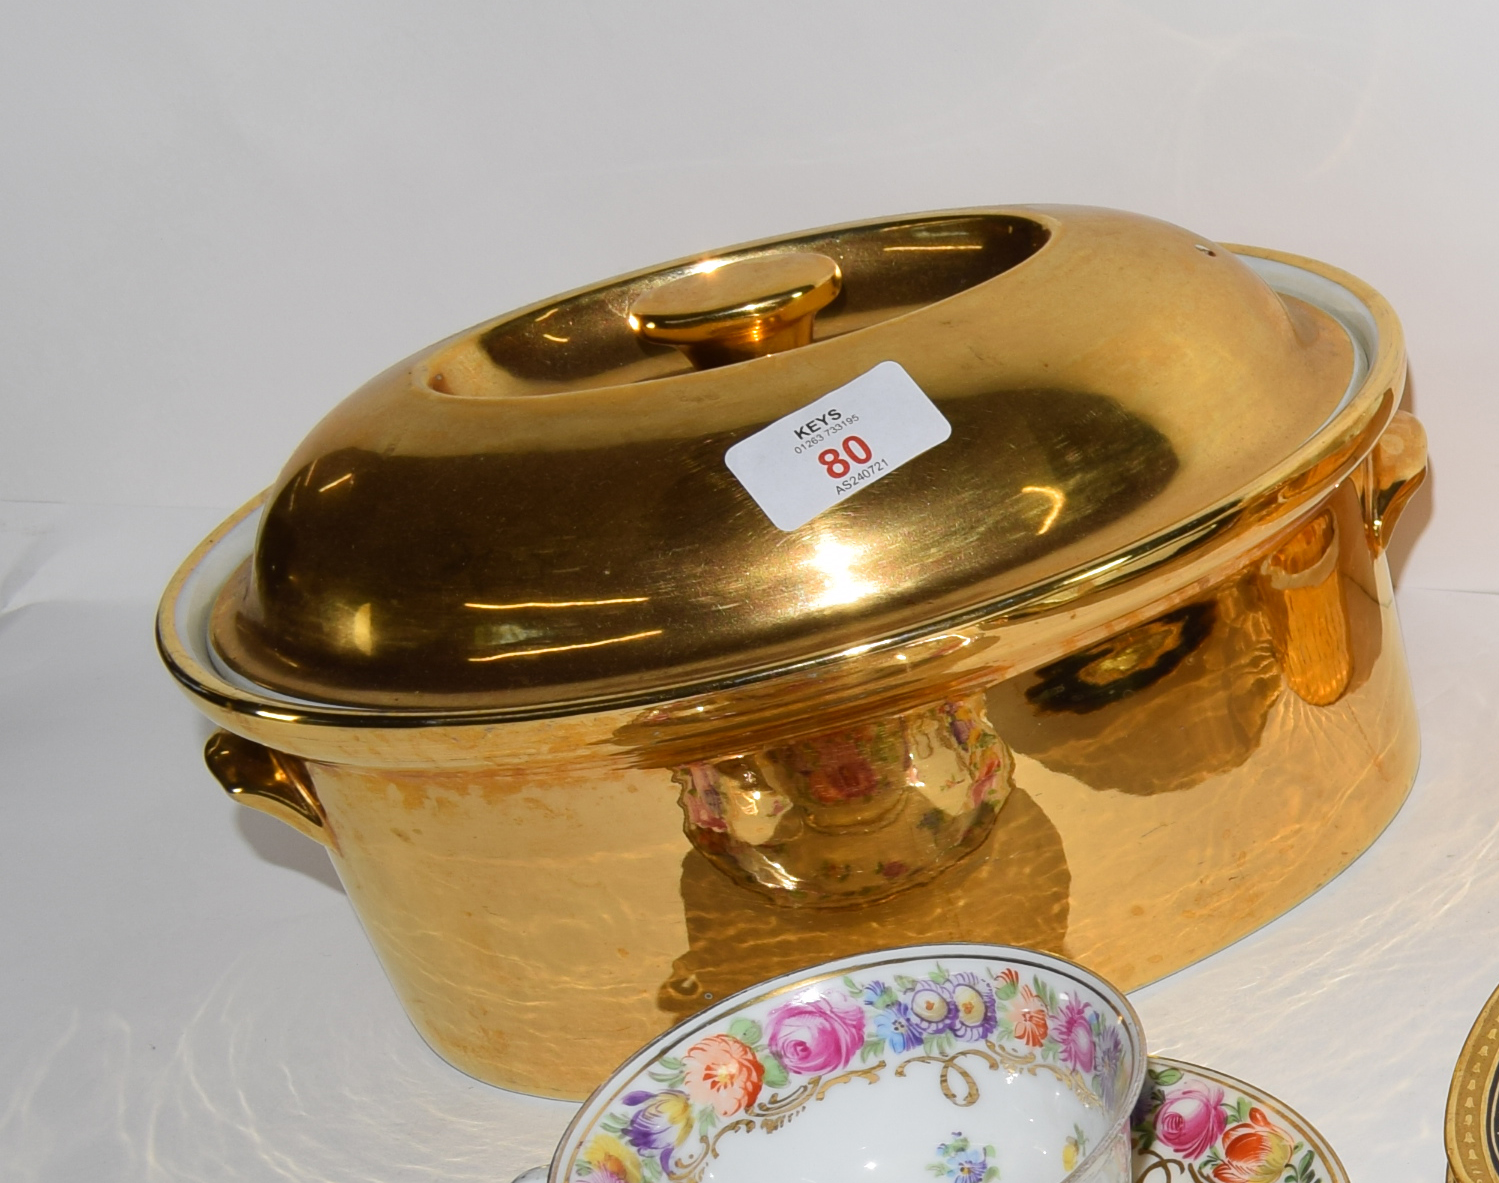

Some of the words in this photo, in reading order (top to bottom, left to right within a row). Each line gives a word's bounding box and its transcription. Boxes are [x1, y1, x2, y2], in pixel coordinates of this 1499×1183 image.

[794, 409, 842, 440] KEYS
[794, 434, 824, 454] 01263
[824, 414, 859, 436] 733195
[818, 435, 872, 479] 80
[836, 458, 889, 495] AS240721
